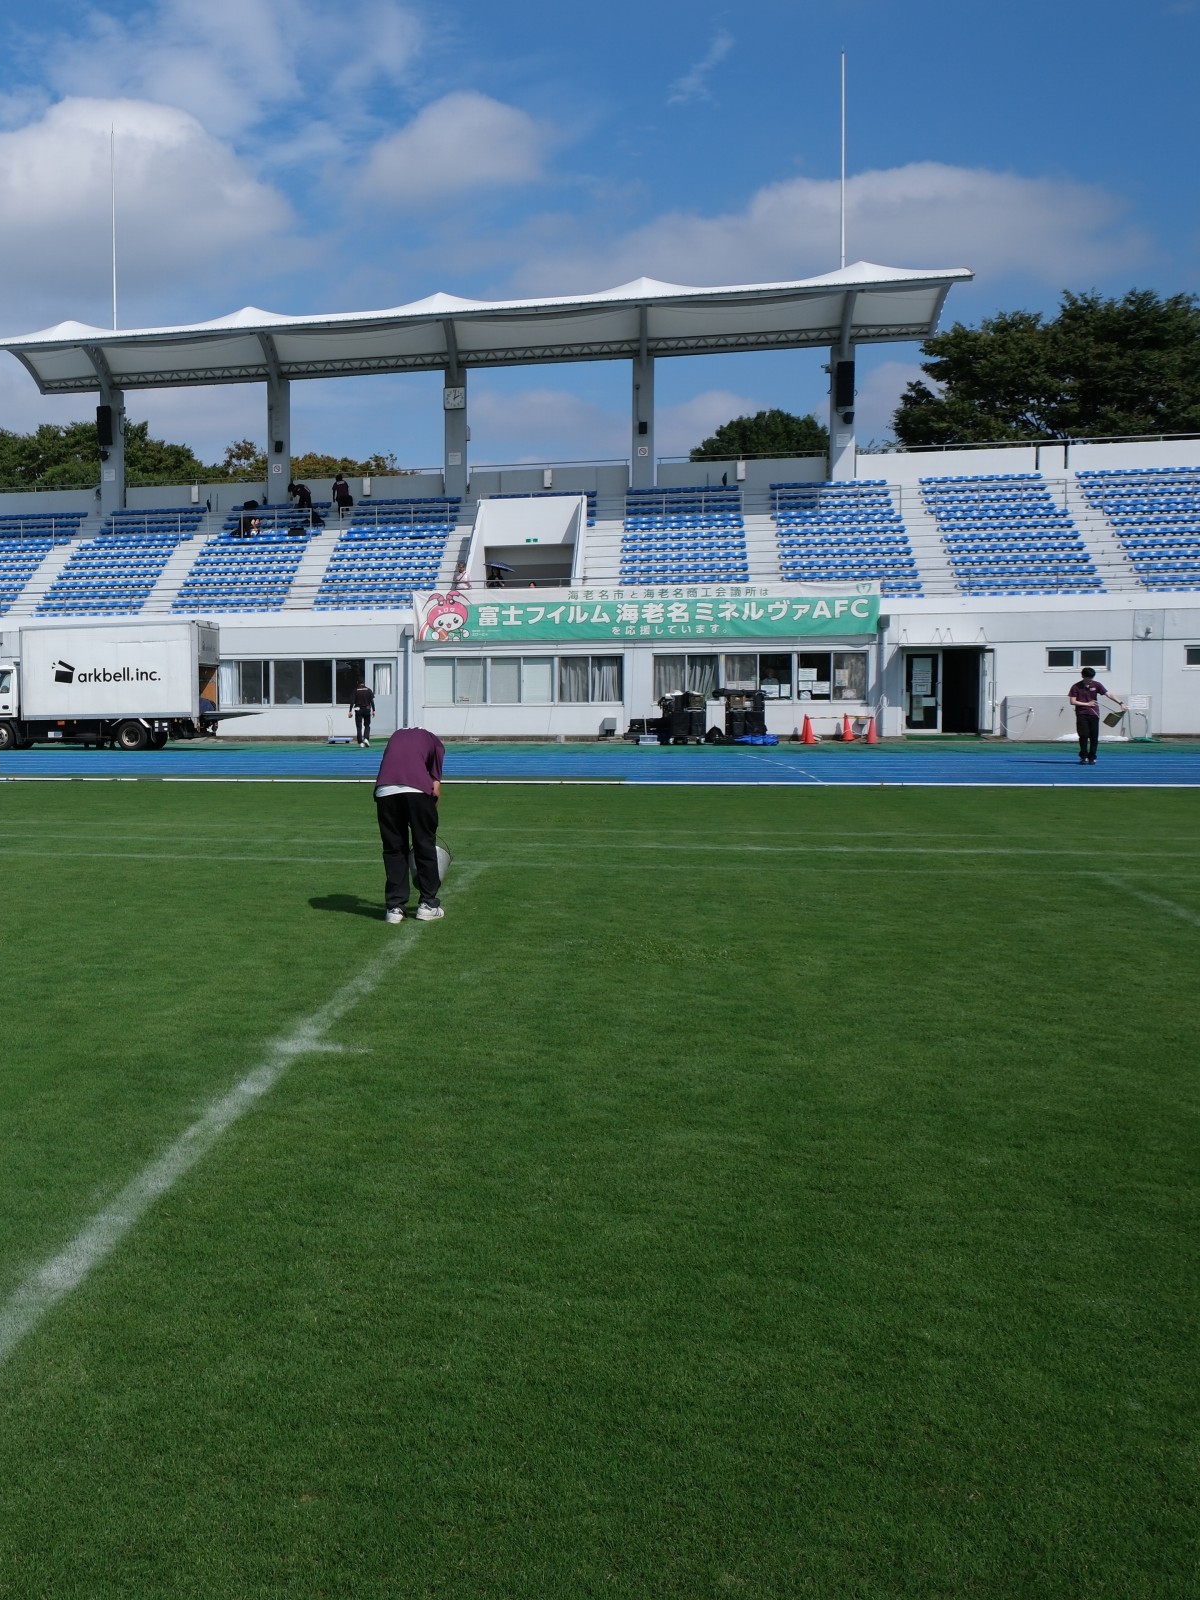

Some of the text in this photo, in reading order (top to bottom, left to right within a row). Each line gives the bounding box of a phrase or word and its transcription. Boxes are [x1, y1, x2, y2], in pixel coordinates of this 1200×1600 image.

[612, 624, 727, 635] を応援しています。
